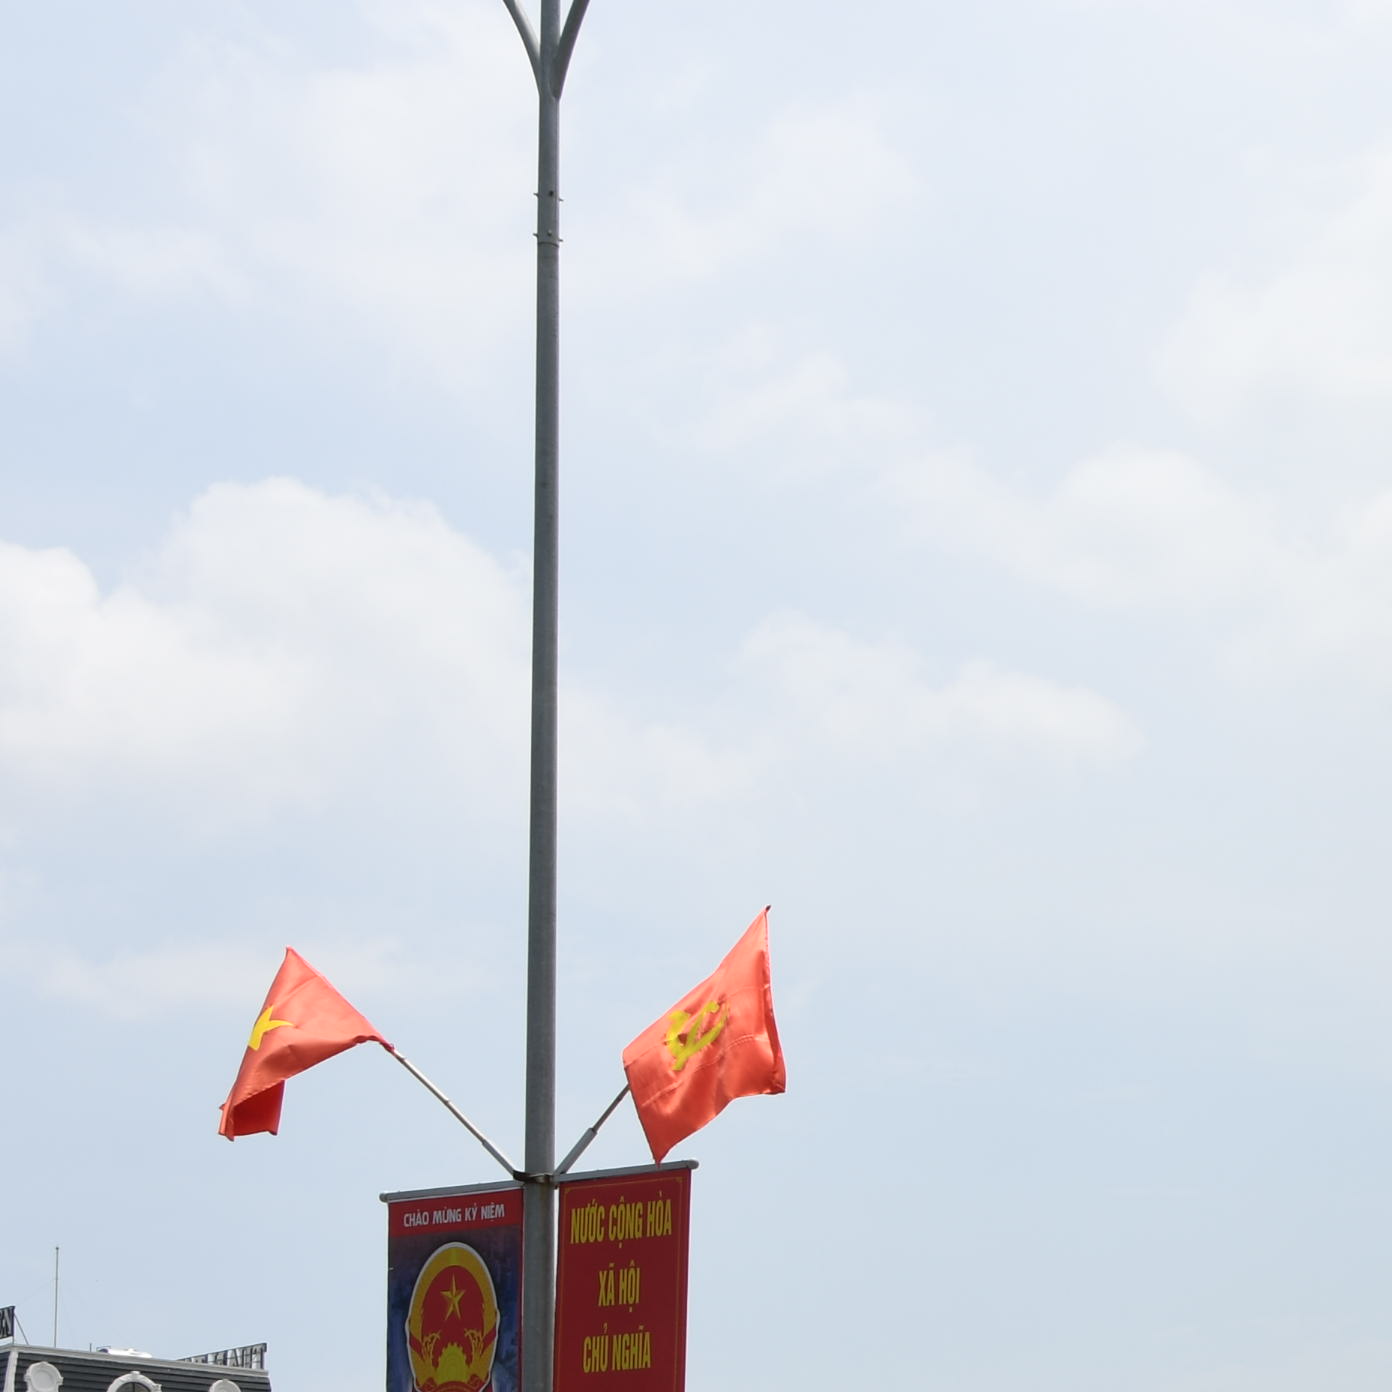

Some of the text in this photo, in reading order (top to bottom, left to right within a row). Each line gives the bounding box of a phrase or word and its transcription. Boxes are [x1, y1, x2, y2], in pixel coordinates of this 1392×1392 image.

[570, 1190, 672, 1249] NƯỚC CỘNG HÒA
[598, 1259, 640, 1313] XÃ HỘI
[583, 1322, 651, 1373] CHỦ NGHĨA
